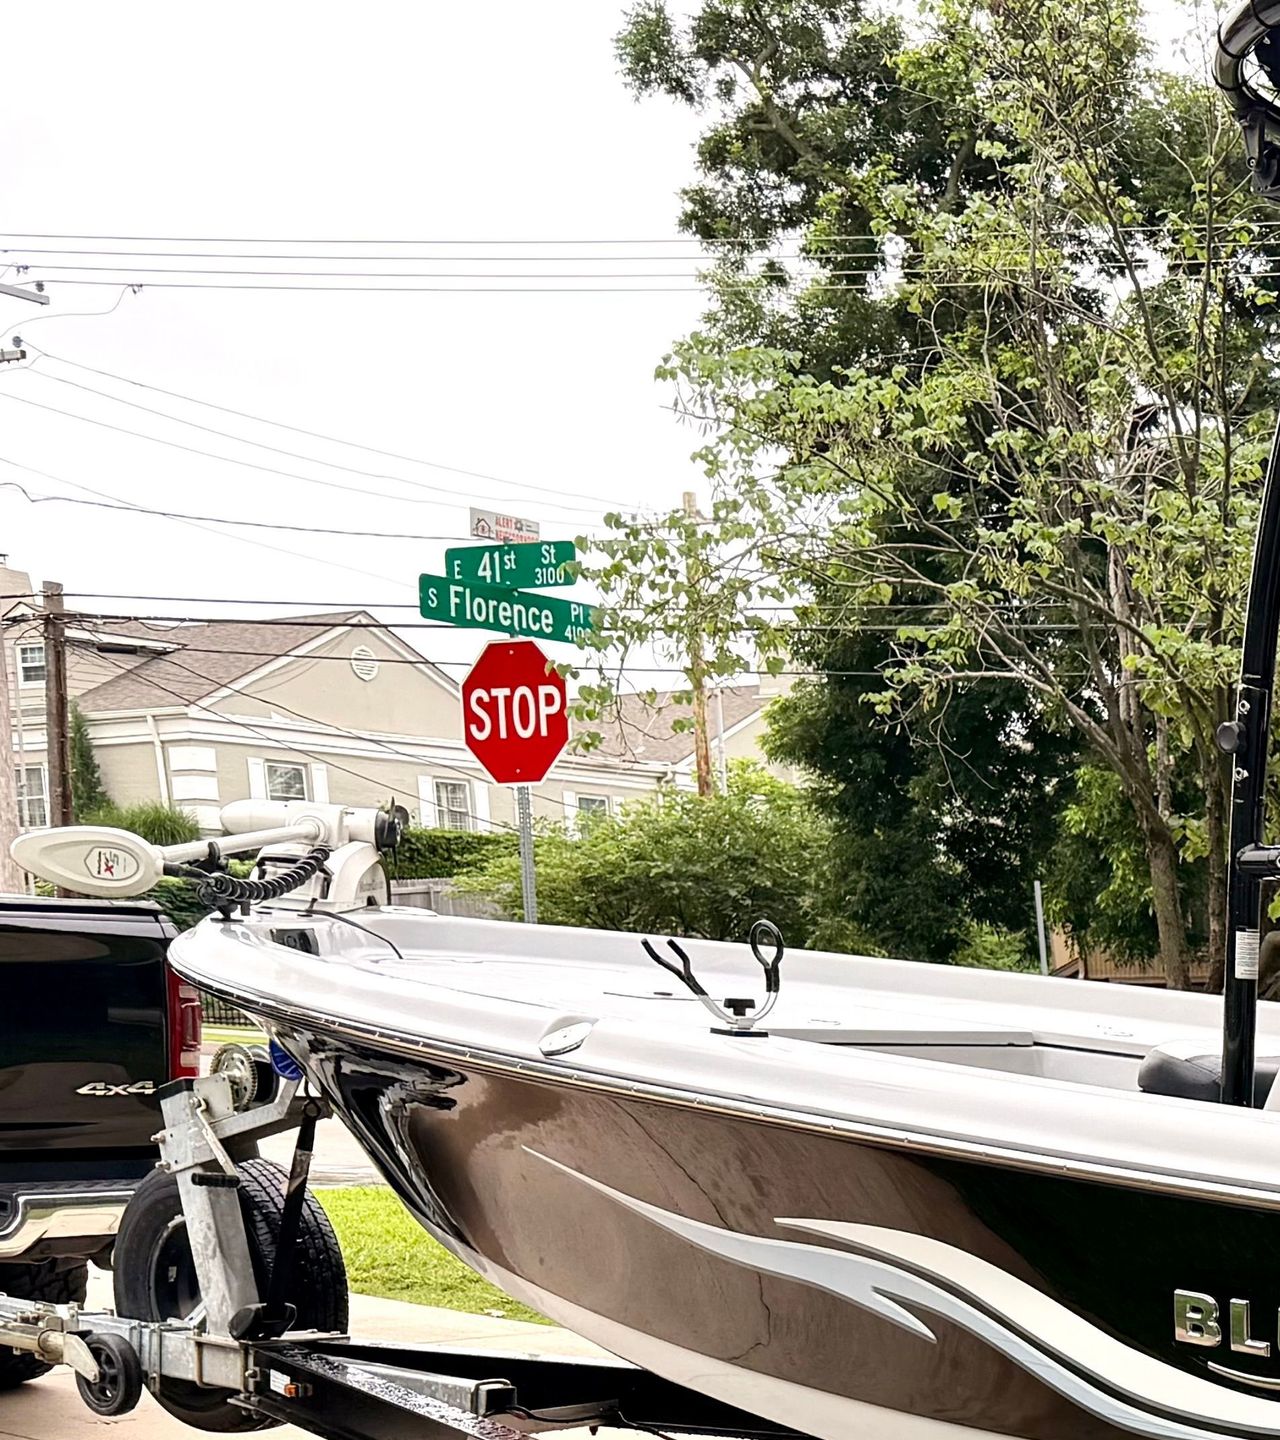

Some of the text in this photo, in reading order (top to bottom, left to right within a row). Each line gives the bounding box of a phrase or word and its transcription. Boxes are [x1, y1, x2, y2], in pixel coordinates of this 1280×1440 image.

[454, 545, 556, 584] E 41st St
[535, 567, 565, 585] 3100
[428, 587, 438, 608] S
[450, 585, 554, 634] Florence
[469, 685, 562, 741] STOP
[76, 1080, 157, 1096] 4x4
